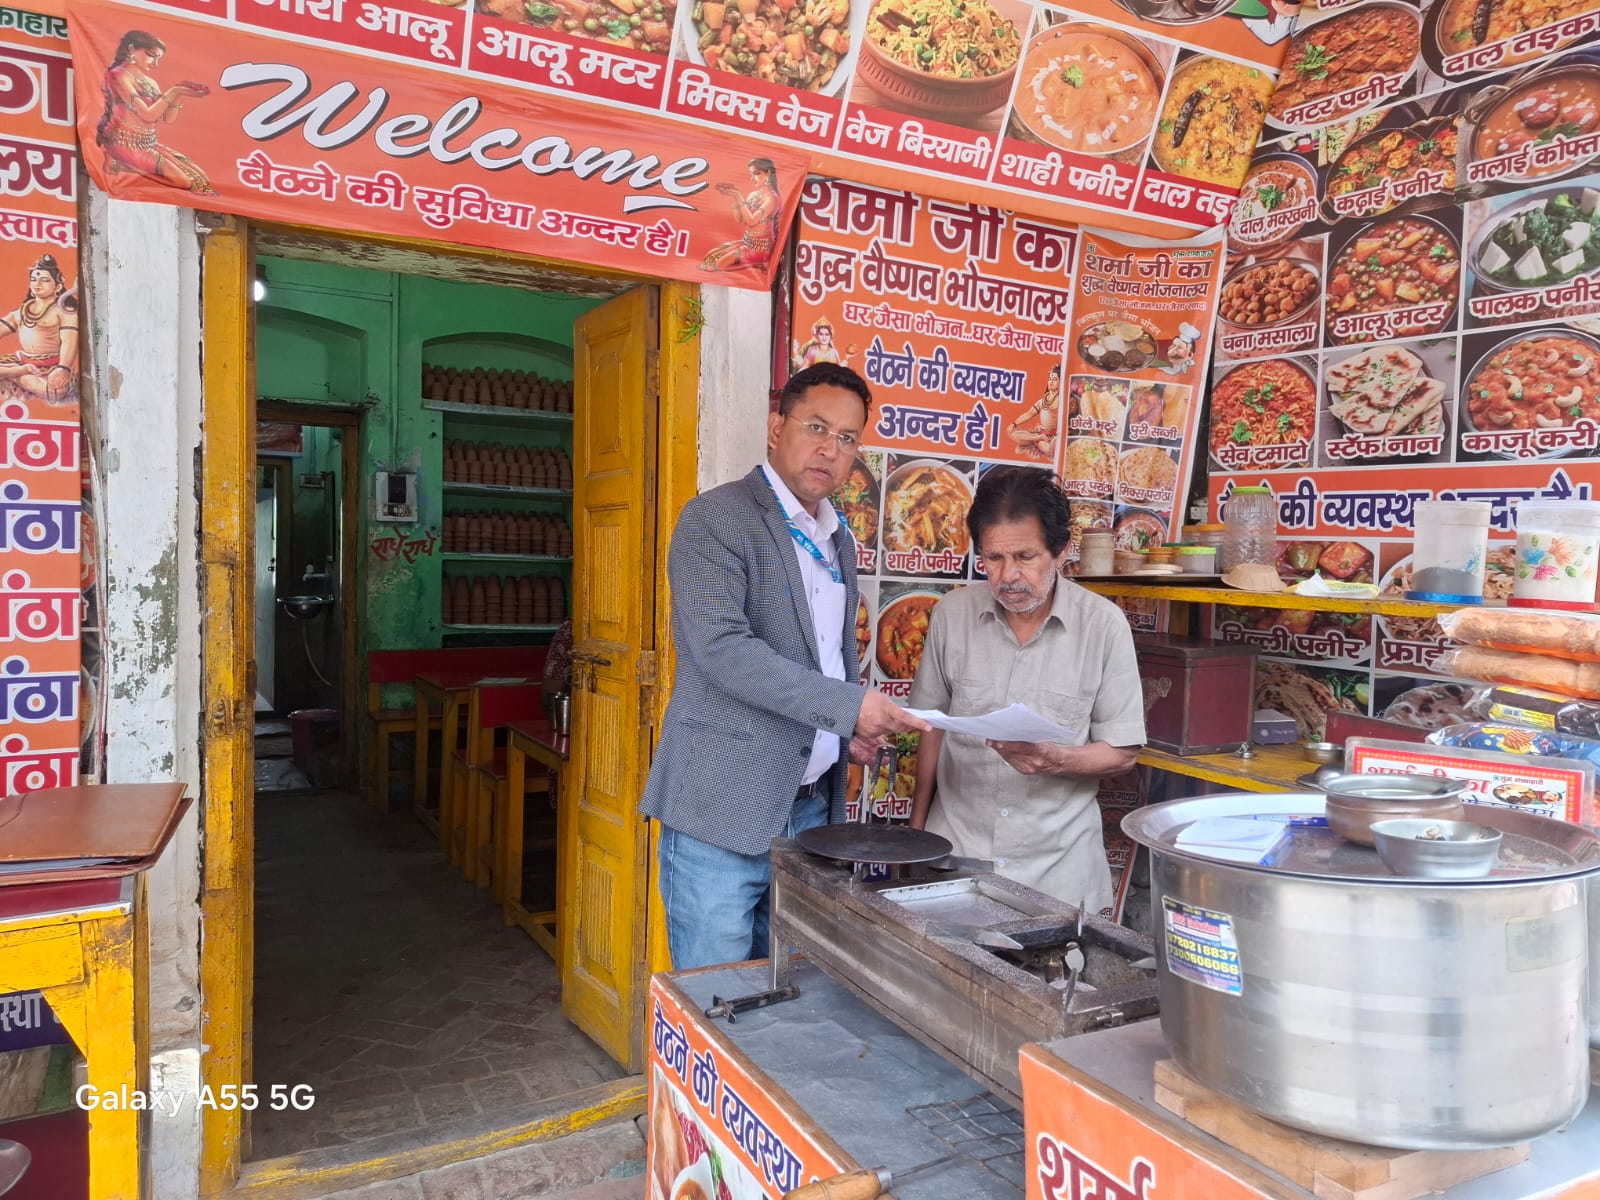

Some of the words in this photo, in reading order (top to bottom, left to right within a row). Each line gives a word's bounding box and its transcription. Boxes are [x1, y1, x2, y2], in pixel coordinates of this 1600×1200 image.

[356, 3, 455, 60] आलू
[476, 26, 574, 86] आलू
[578, 46, 662, 89] मटर
[1445, 44, 1505, 75] दाल
[677, 69, 771, 123] मिक्स
[775, 93, 832, 138] वेज
[1285, 97, 1335, 125] मटर
[1339, 76, 1403, 109] पनीर
[219, 61, 709, 197] Welcome
[846, 109, 893, 149] वेज
[898, 119, 991, 170] बिरयानी
[1000, 152, 1063, 191] शाही
[1067, 163, 1134, 201] पनीर
[1469, 148, 1530, 182] मलाई
[236, 146, 338, 200] बैठने
[345, 168, 404, 211] की
[412, 182, 534, 230] सुविधा
[536, 207, 642, 248] अन्दर
[1144, 176, 1192, 209] दाल
[1390, 171, 1445, 200] पनीर
[1239, 217, 1264, 237] दाल
[1266, 199, 1319, 233] मक्खनी
[797, 242, 856, 303] शुद्ध
[860, 240, 940, 301] वैष्णव
[1086, 252, 1134, 277] शर्मा
[1138, 253, 1173, 278] जी
[1178, 259, 1214, 279] का
[1082, 274, 1104, 296] शुद्ध
[1107, 275, 1142, 296] वैष्णव
[1144, 278, 1209, 299] भोजनालय
[1471, 292, 1540, 317] पालक
[843, 302, 873, 324] घर
[875, 307, 912, 330] जैसा
[998, 327, 1033, 350] जैसा
[1222, 335, 1252, 351] चना
[1256, 324, 1314, 348] मसाला
[1337, 315, 1388, 343] आलू
[1391, 304, 1446, 328] मटर
[864, 335, 915, 388] बैठने
[917, 346, 950, 392] की
[951, 362, 1026, 402] व्यवस्था
[876, 402, 961, 445] अन्दर
[1464, 431, 1534, 459] काजू
[1537, 420, 1597, 449] करी
[1219, 447, 1250, 465] सेव
[1250, 441, 1308, 463] टमाटो
[1386, 434, 1442, 455] नान
[1280, 479, 1318, 528] की
[887, 547, 923, 573] शाही
[925, 549, 963, 574] पनीर
[1294, 633, 1362, 659] पनीर
[692, 1050, 719, 1117] की
